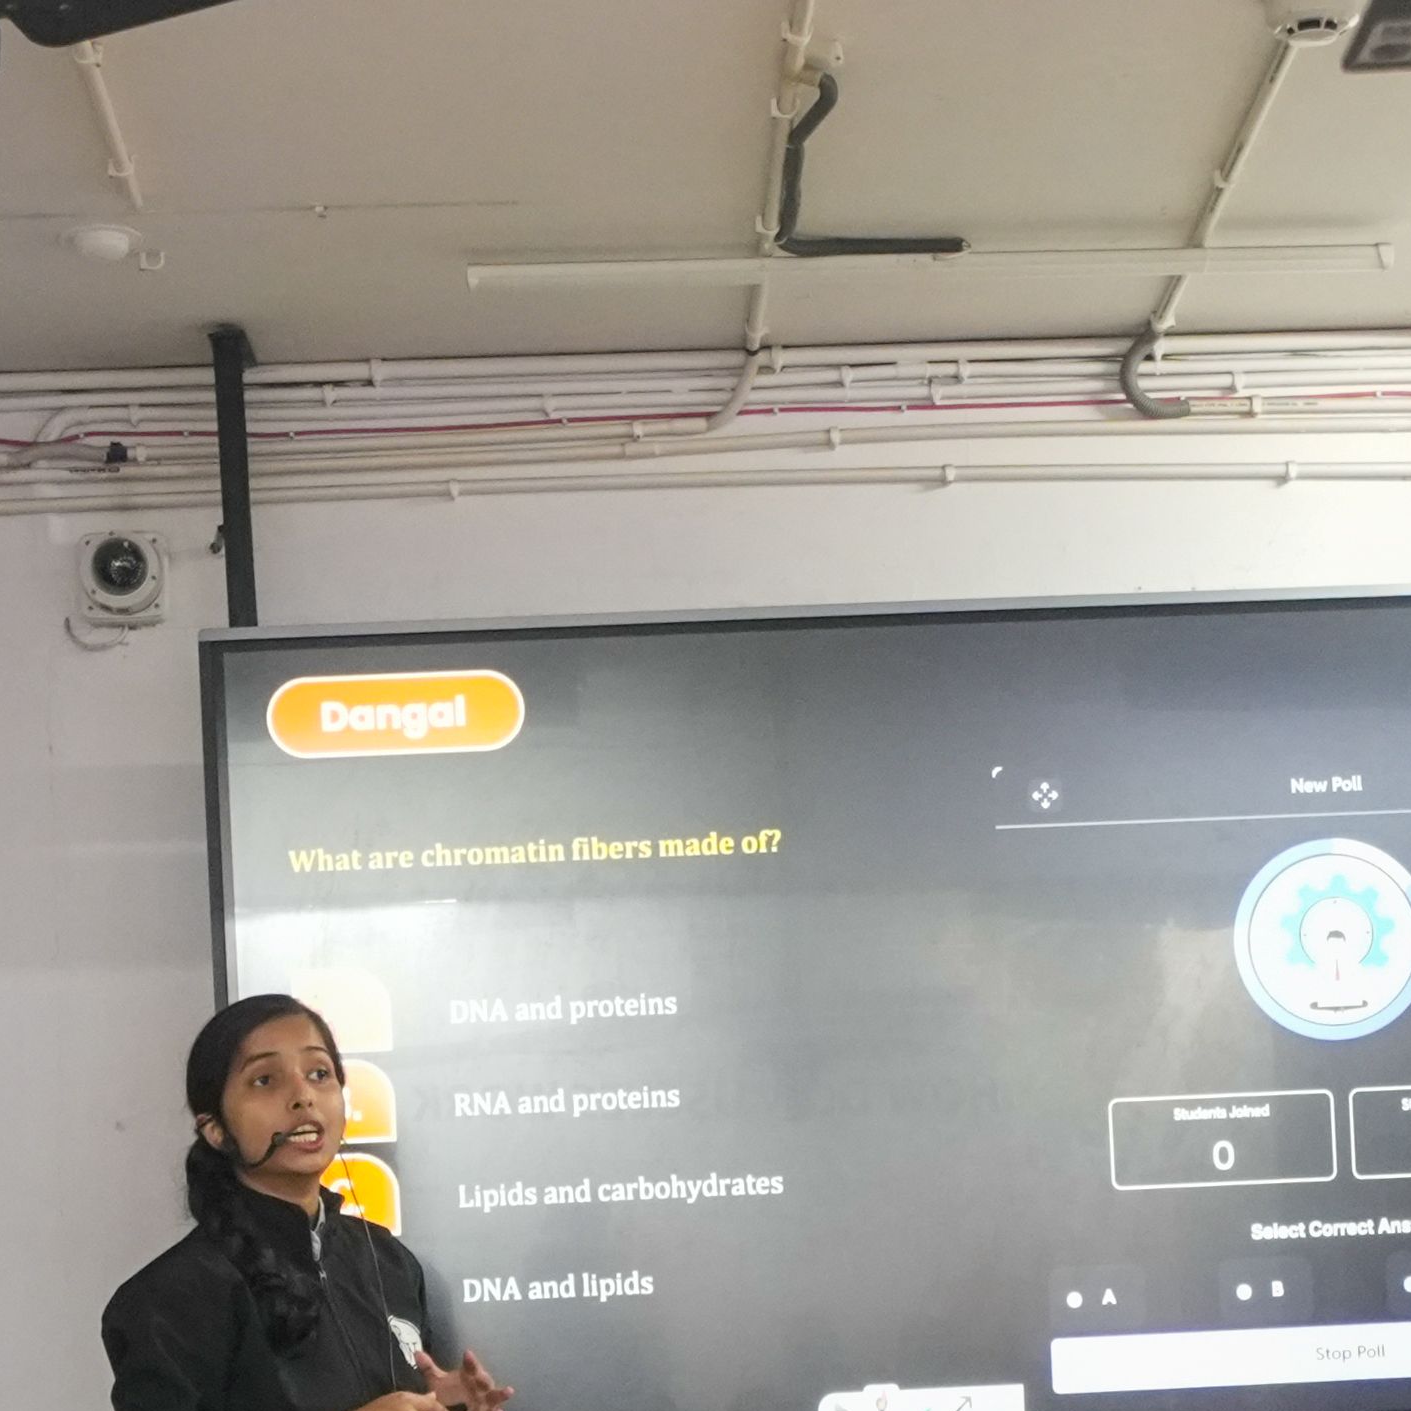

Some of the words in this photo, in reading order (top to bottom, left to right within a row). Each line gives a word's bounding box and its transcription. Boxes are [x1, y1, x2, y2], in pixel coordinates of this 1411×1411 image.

[320, 694, 466, 740] Dangal
[1290, 776, 1327, 795] New
[1332, 774, 1363, 793] Poll
[289, 846, 362, 873] What
[368, 850, 414, 871] are
[421, 839, 566, 868] chromatin
[571, 836, 652, 862] fibers
[659, 832, 734, 858] made
[741, 828, 782, 855] of?
[449, 999, 507, 1025] DNA
[514, 996, 563, 1022] and
[569, 993, 678, 1024] proteins
[454, 1091, 510, 1117] RNA
[517, 1088, 565, 1114] and
[572, 1085, 681, 1117] proteins
[1173, 1104, 1225, 1121] Students
[1229, 1102, 1270, 1120] Joined
[1212, 1140, 1236, 1171] 0
[458, 1183, 538, 1213] Lipids
[544, 1178, 591, 1205] and
[597, 1172, 784, 1206] carbohydrates
[1250, 1220, 1306, 1240] Select
[1308, 1217, 1375, 1237] Correct
[463, 1277, 523, 1303] DNA
[528, 1273, 577, 1299] and
[582, 1270, 655, 1304] lipids
[1101, 1288, 1117, 1305] A
[1271, 1280, 1285, 1298] B
[1315, 1344, 1350, 1363] Stop
[1354, 1342, 1386, 1360] Poll
